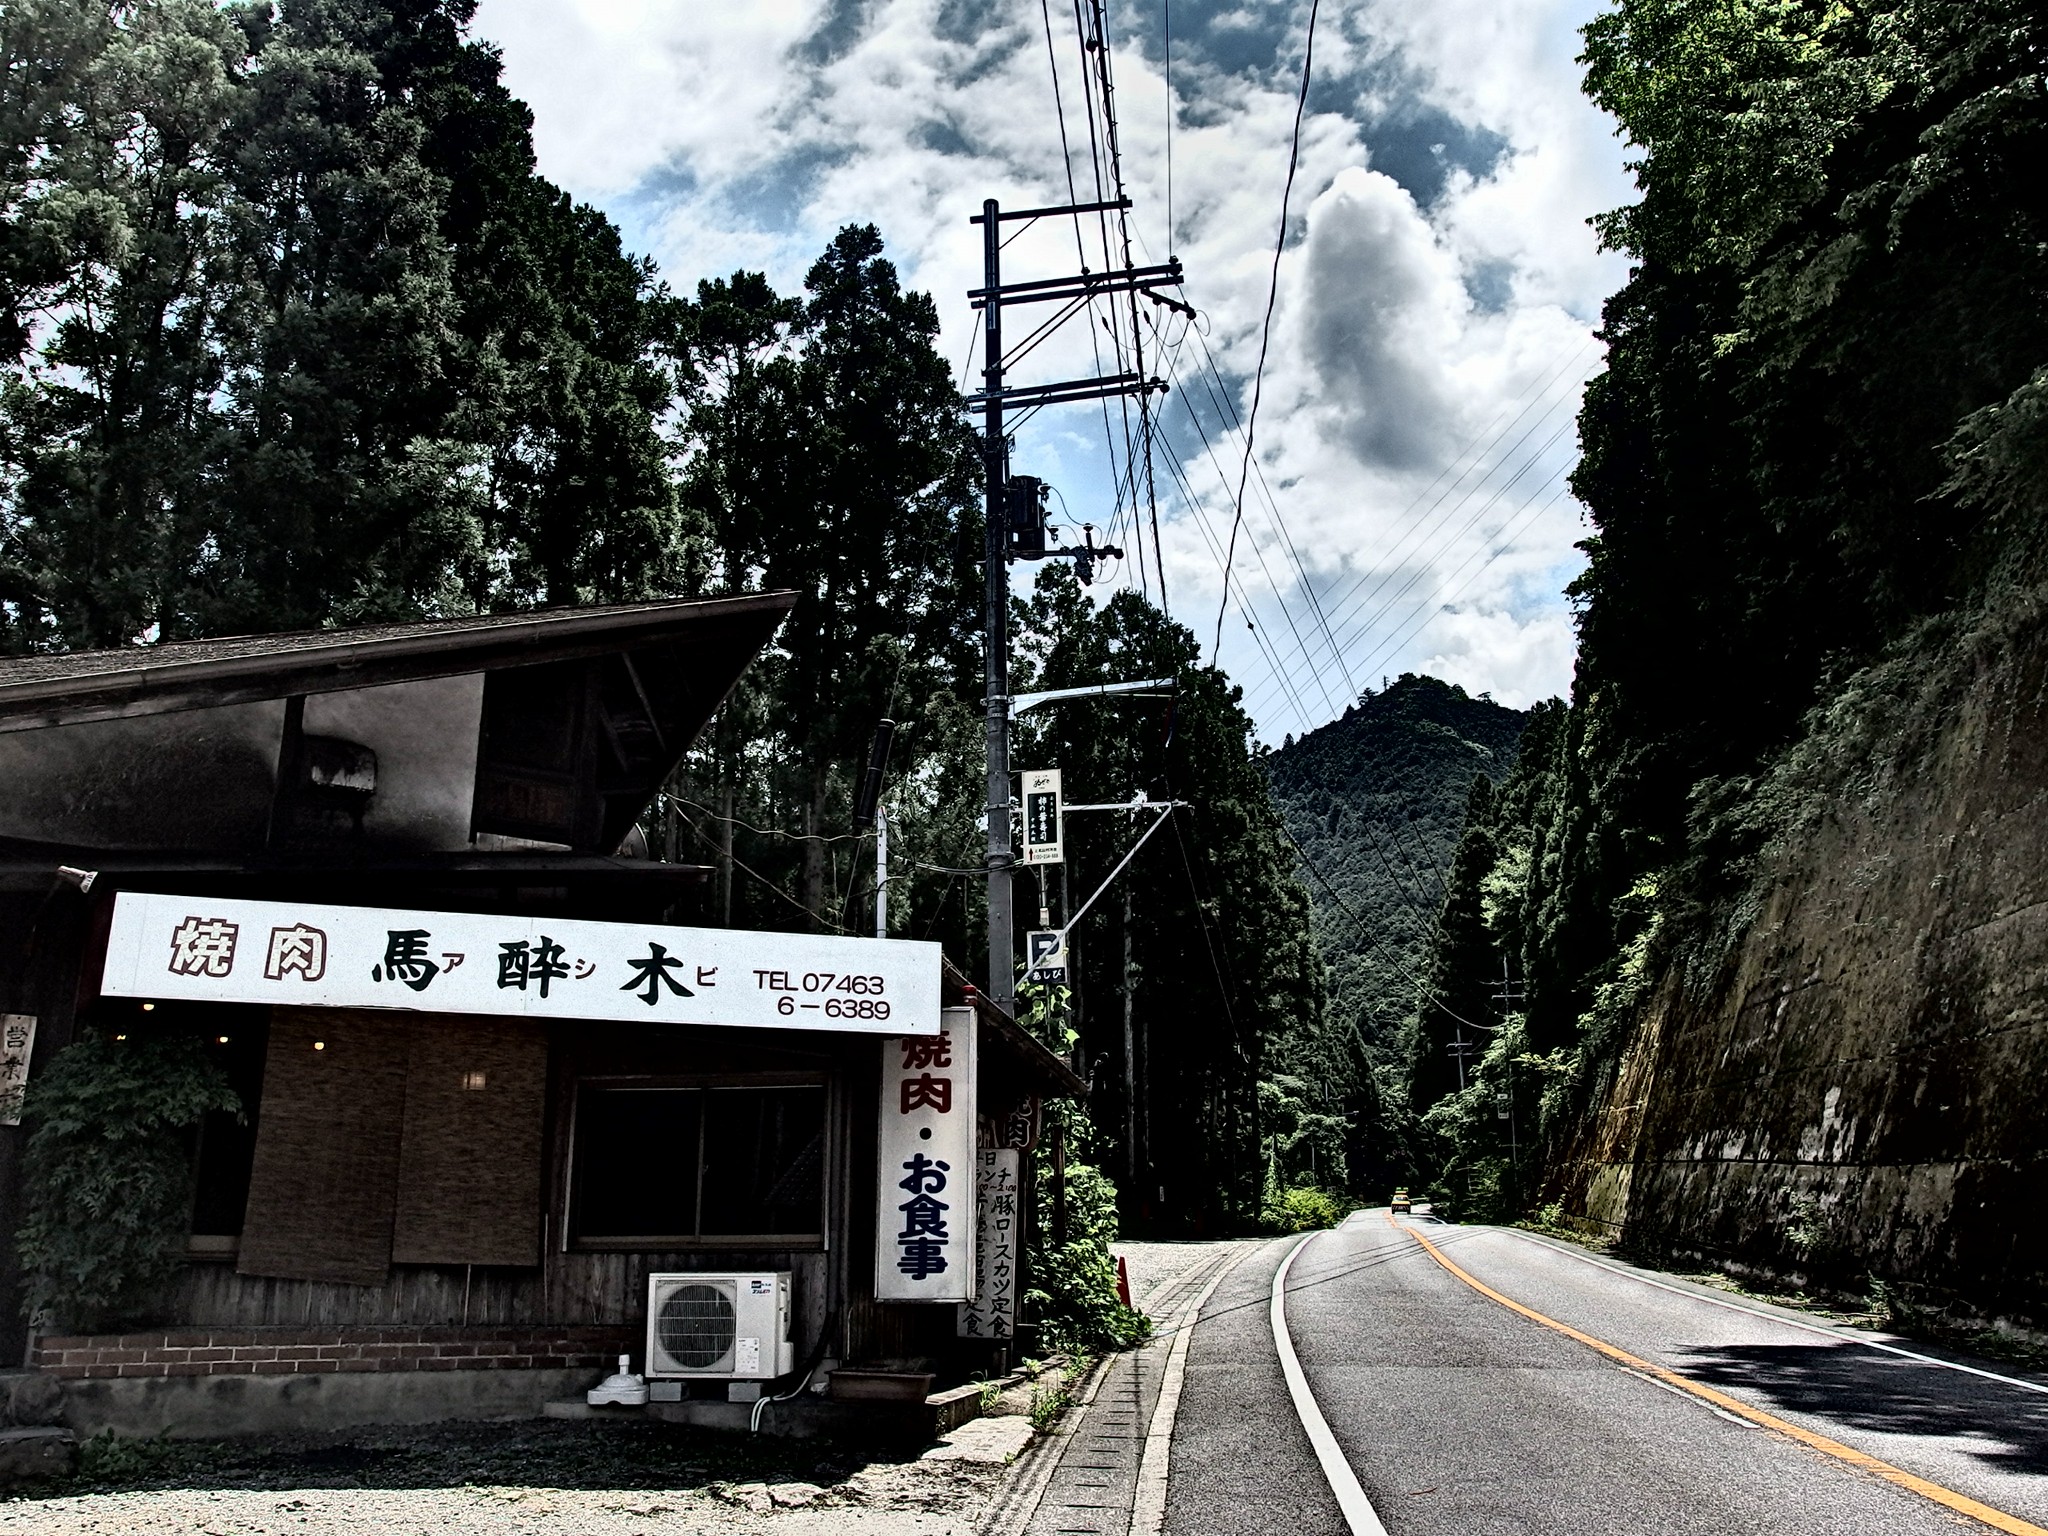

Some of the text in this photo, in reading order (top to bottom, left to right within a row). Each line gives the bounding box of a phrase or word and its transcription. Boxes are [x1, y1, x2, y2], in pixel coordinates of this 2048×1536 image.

[1031, 933, 1060, 968] P
[803, 972, 885, 996] 07463
[1033, 969, 1062, 981] あしび
[0, 1026, 28, 1112] 営業
[987, 1193, 1016, 1338] 豚ロースカツ定食
